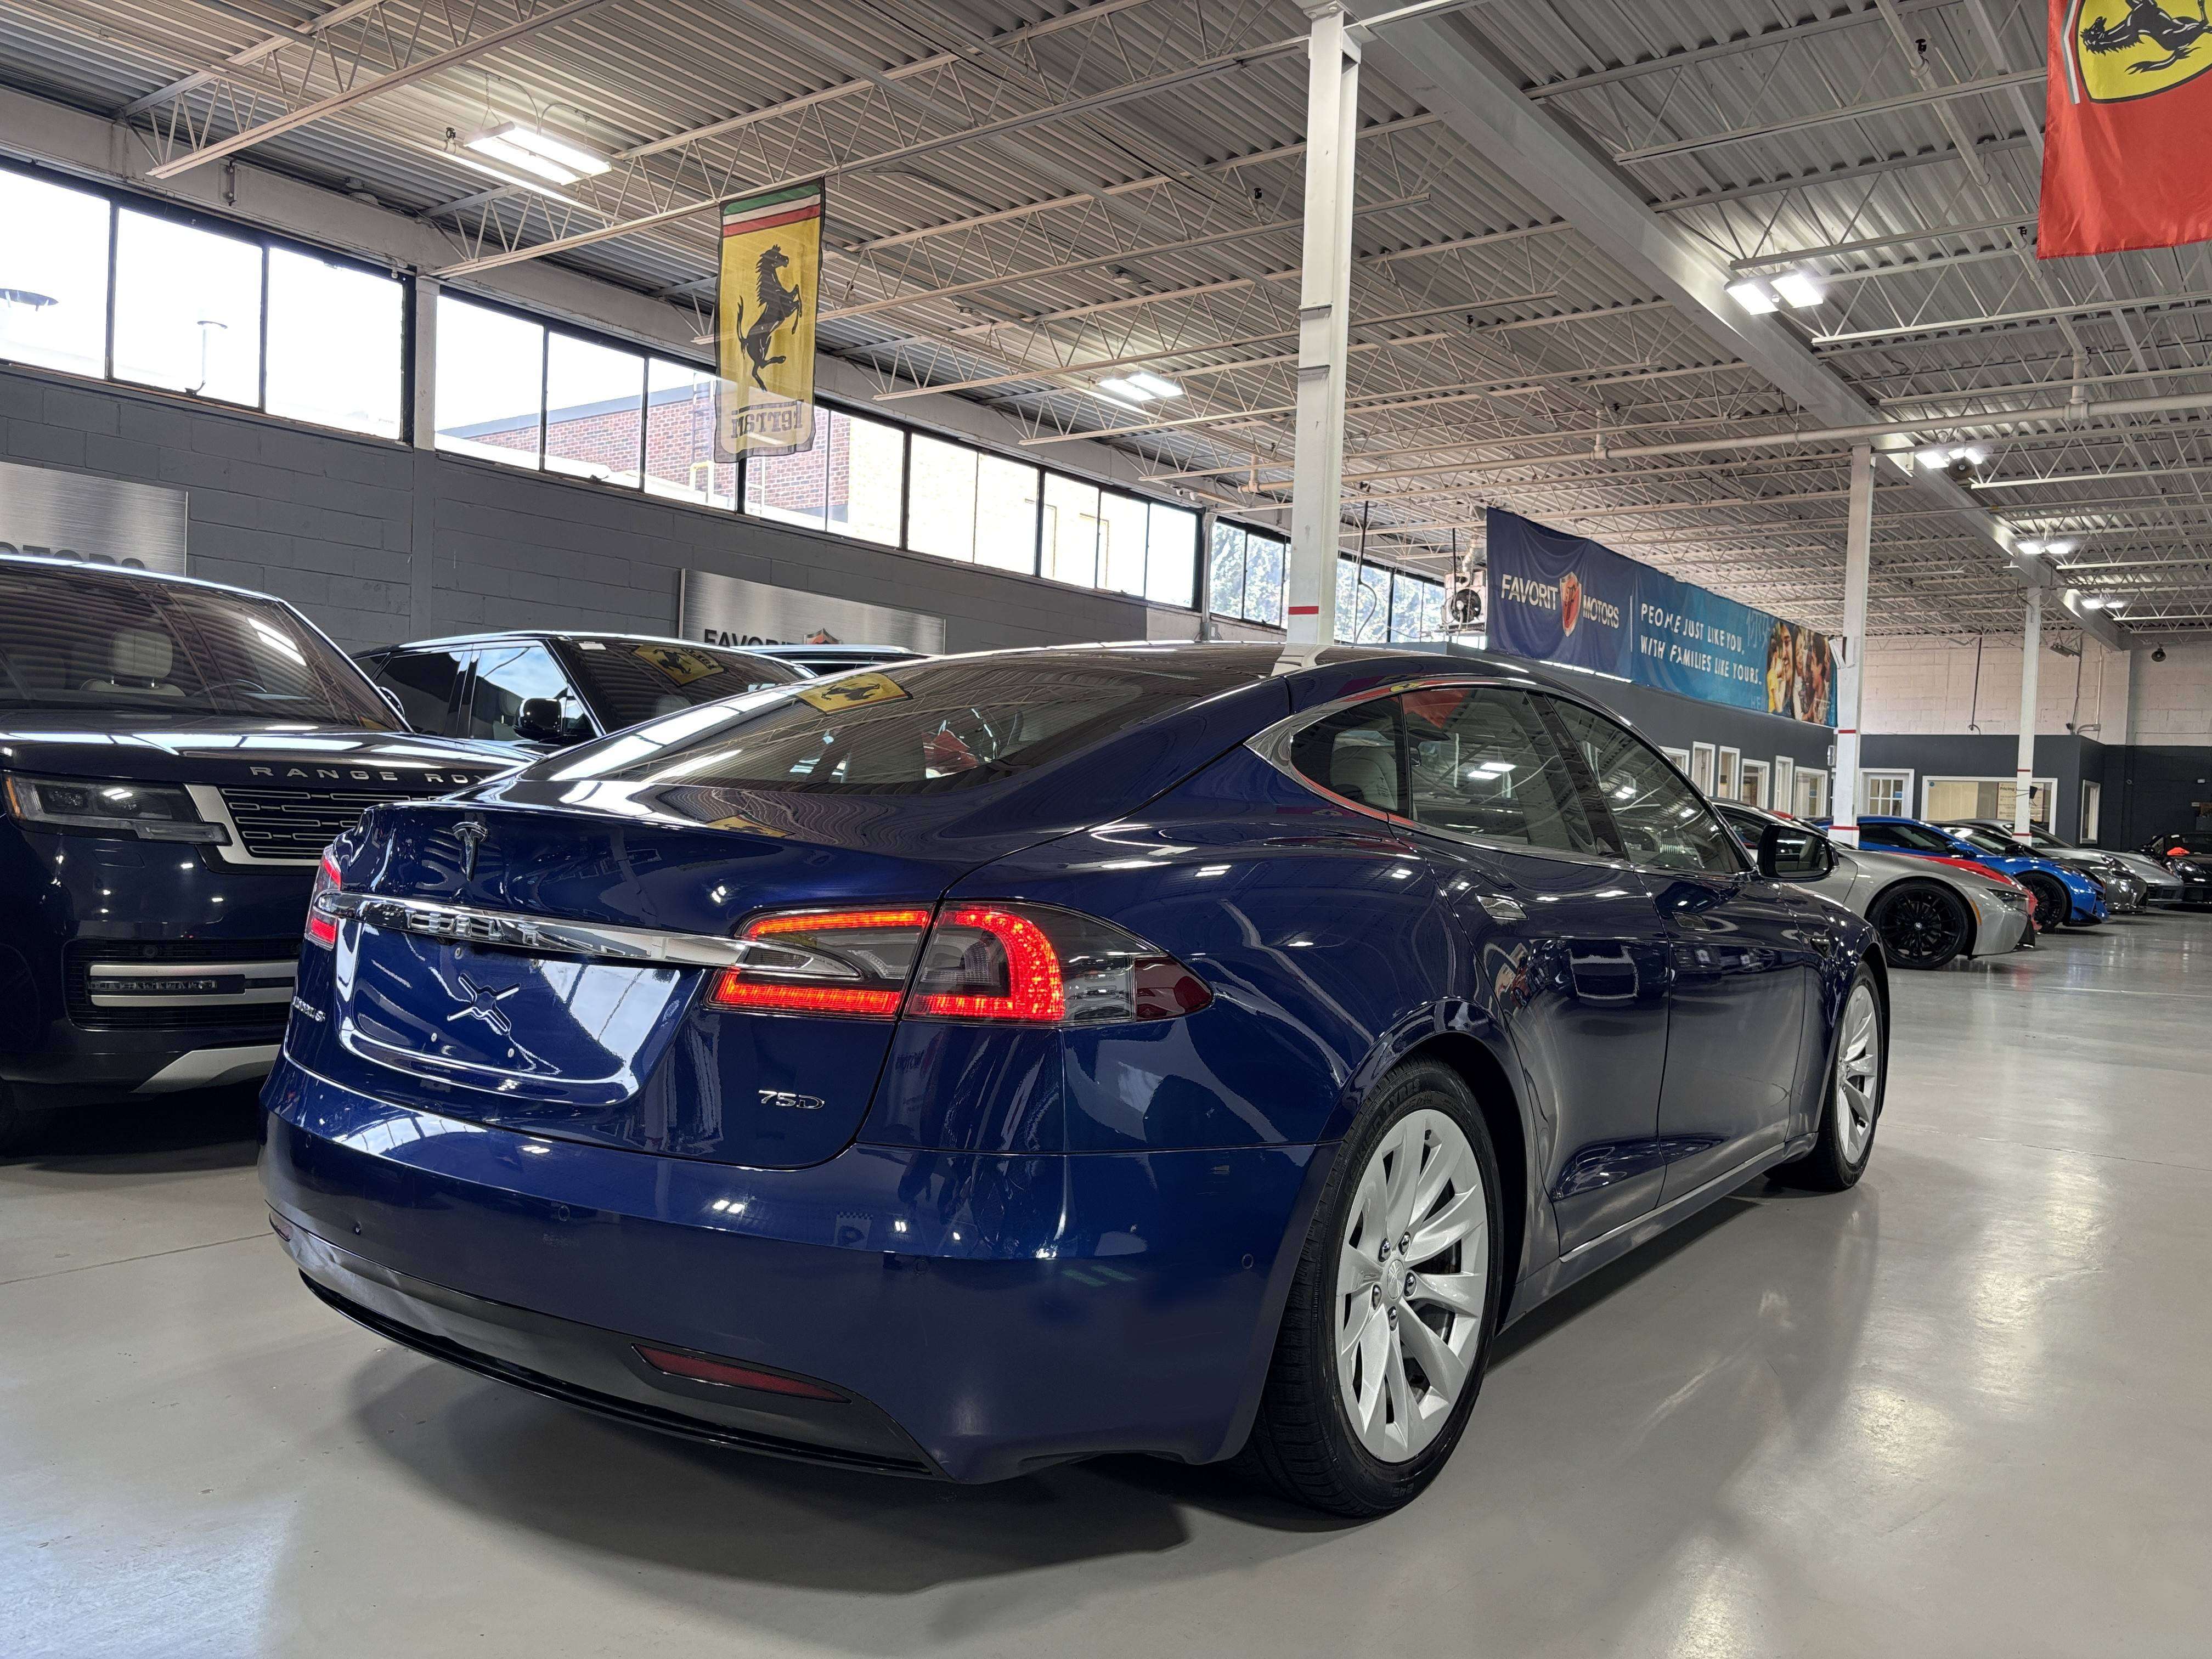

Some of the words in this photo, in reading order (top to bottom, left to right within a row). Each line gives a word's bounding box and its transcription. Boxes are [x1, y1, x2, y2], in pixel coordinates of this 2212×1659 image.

[1501, 574, 1558, 611] FAVORIT
[1583, 594, 1620, 629] MOTORS
[1683, 618, 1705, 641] JUST
[1707, 625, 1725, 647] LIKE
[1641, 635, 1666, 659] WITH
[1669, 644, 1712, 673] FAMILIES
[1714, 657, 1729, 678] LIKE
[250, 766, 398, 781] RANGE
[404, 908, 539, 947] TESLA
[758, 1090, 826, 1110] 75D
